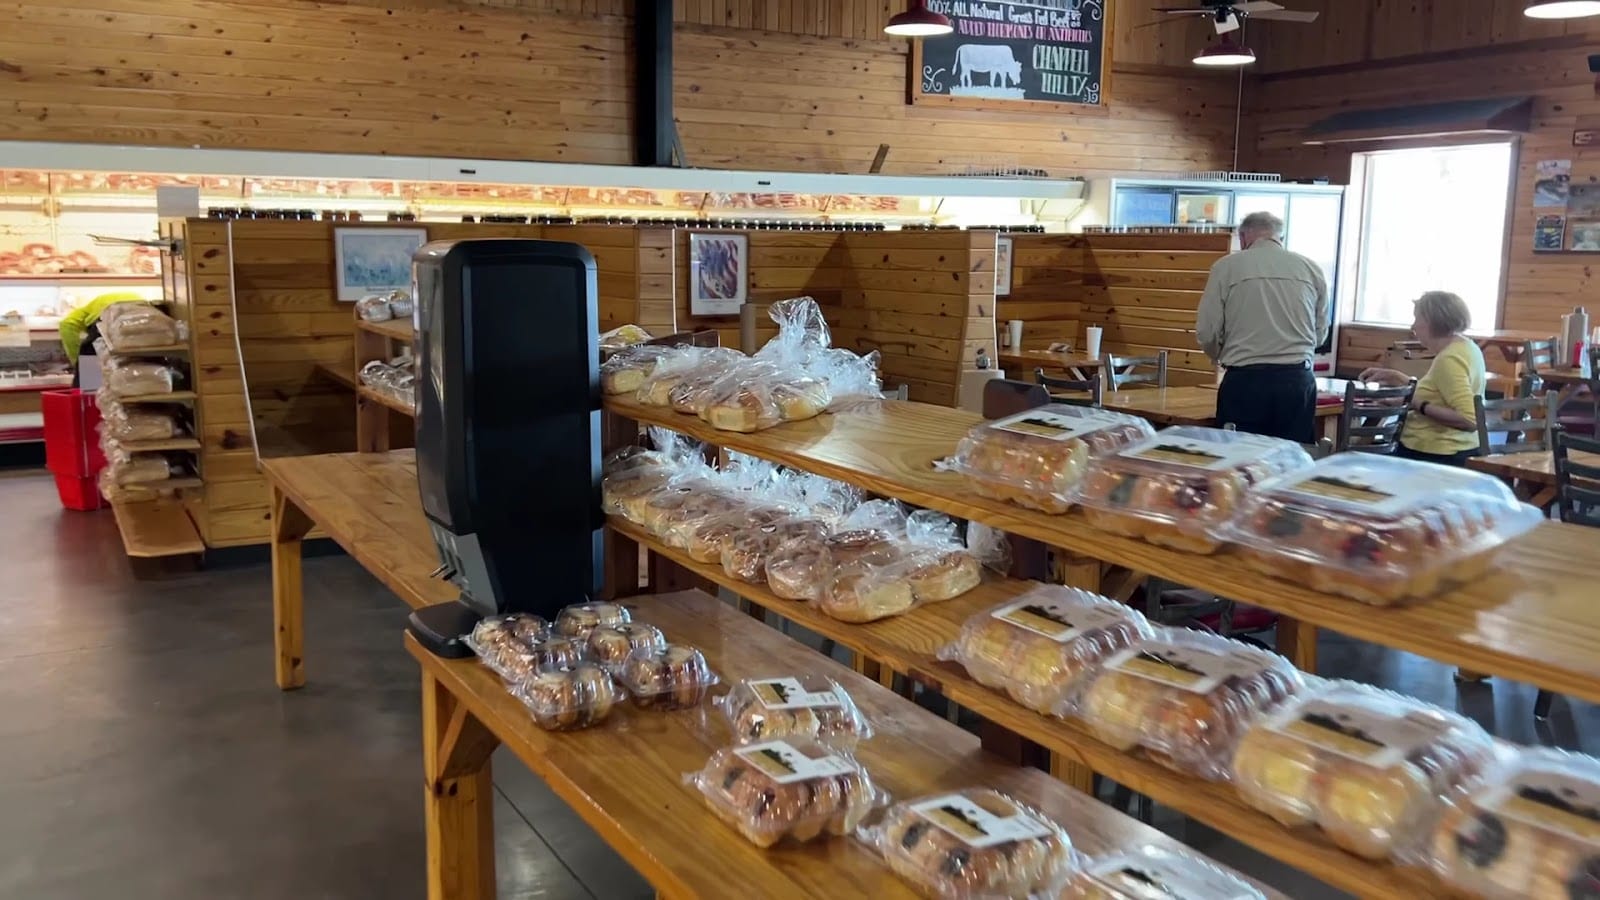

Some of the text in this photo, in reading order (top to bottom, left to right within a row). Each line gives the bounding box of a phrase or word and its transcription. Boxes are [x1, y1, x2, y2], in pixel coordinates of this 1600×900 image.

[953, 1, 969, 16] ALL
[970, 3, 1004, 21] Natural
[1008, 5, 1033, 24] Grass
[1035, 9, 1048, 26] Fed
[1050, 11, 1070, 28] Beef
[1032, 44, 1091, 75] CHAPPELL
